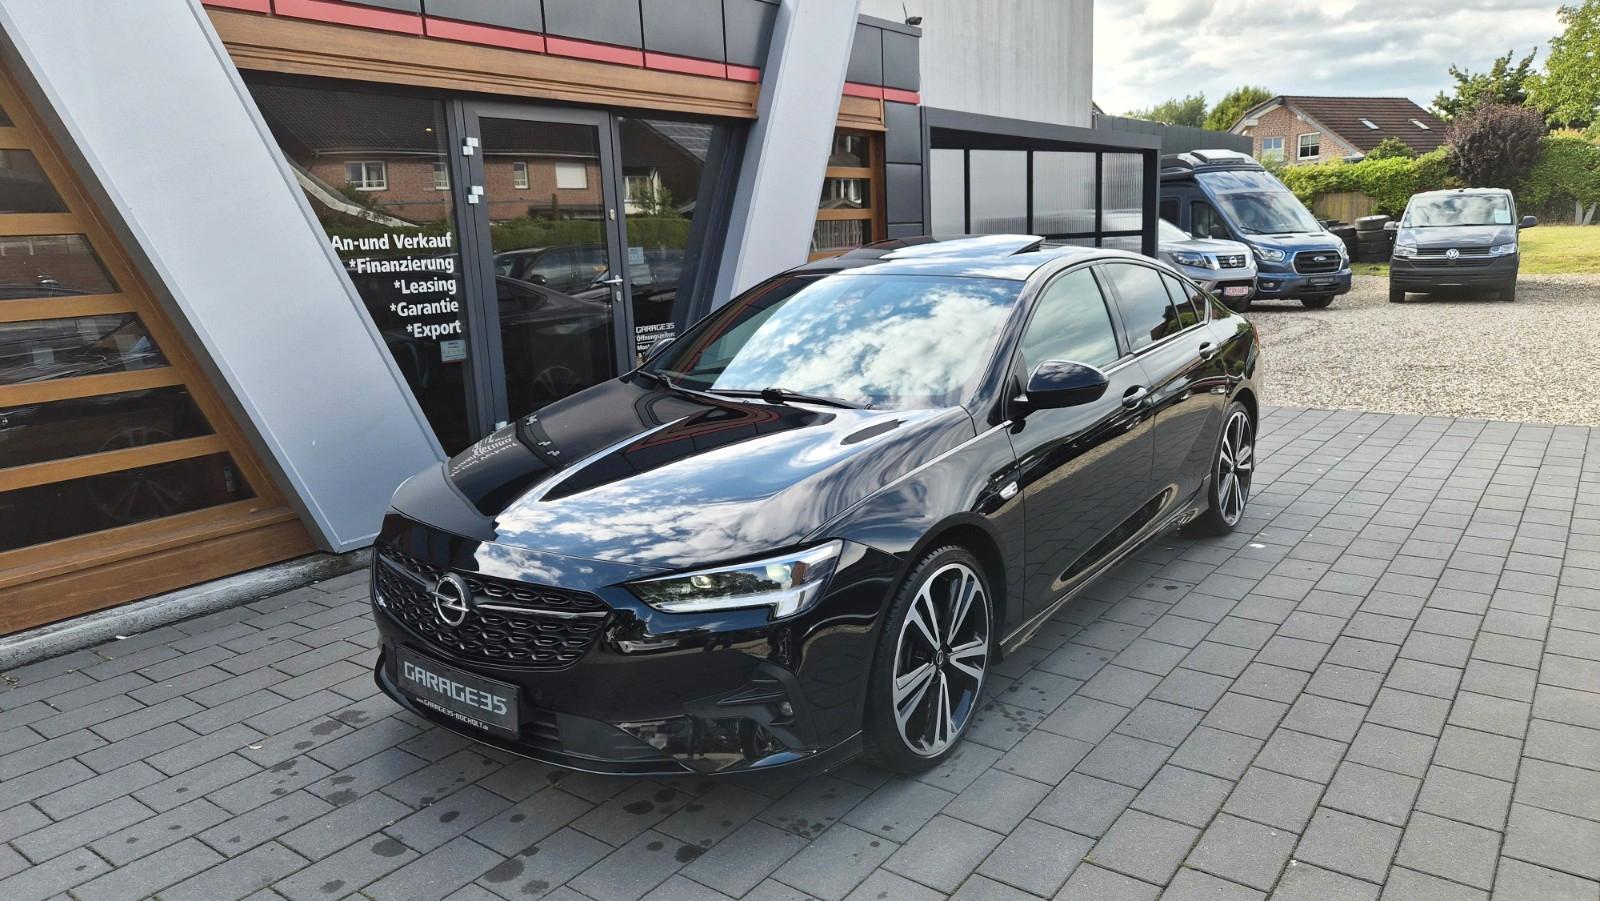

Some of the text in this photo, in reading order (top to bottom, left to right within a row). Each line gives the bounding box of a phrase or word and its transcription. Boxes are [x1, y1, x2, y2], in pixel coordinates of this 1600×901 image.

[331, 232, 452, 251] An-und Verkauf
[404, 661, 507, 715] GARAGE35
